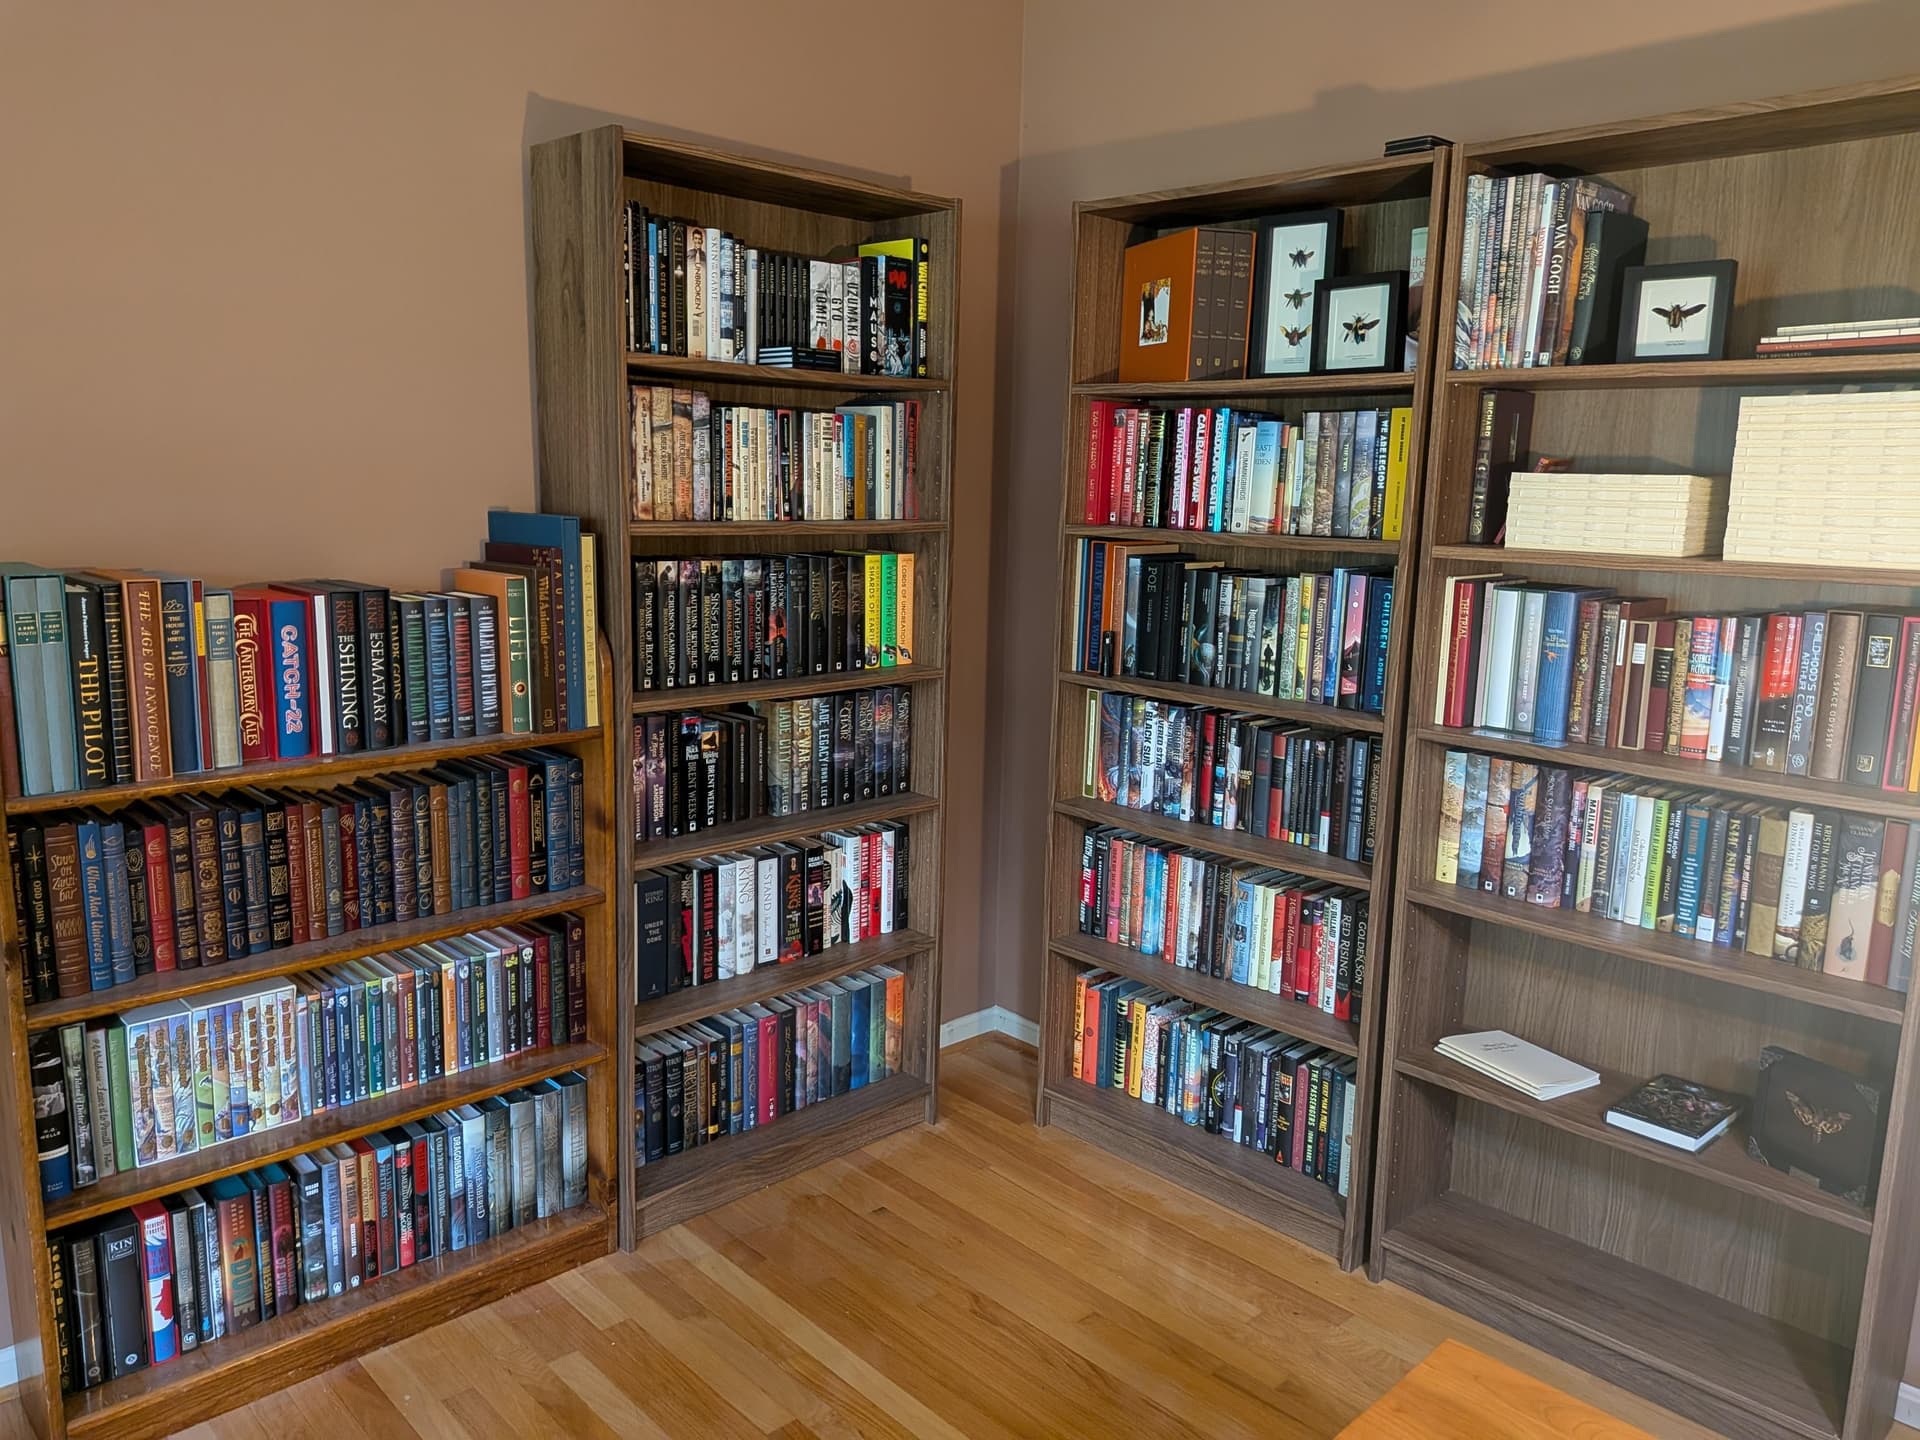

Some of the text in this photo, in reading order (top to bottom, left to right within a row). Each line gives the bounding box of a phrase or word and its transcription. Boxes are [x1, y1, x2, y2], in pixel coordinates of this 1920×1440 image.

[1547, 182, 1569, 294] Essential VAN GOGH
[661, 297, 667, 307] ON
[694, 262, 703, 310] UNBROKEN
[918, 262, 927, 322] WATCHMEN
[816, 290, 827, 327] TOMIE
[832, 298, 842, 322] GYO
[847, 282, 858, 336] UZUMAKI
[1125, 420, 1135, 455] DESTROYER
[1485, 401, 1493, 437] RICHARD
[1171, 413, 1185, 512] LEVIATHAN WAKES
[1192, 414, 1206, 503] CALIBAN'S WAR
[1208, 413, 1224, 514] ABADDON'S GATE
[1239, 450, 1248, 501] HUMMINGBIRDS
[1377, 420, 1388, 489] WE ARE LEGION
[1123, 466, 1131, 493] WORLDS
[539, 575, 549, 600] Wild
[868, 566, 876, 593] SHARDS
[900, 589, 906, 598] OF
[1147, 567, 1158, 593] POE
[335, 600, 346, 633] KING
[367, 597, 377, 629] KING
[667, 595, 675, 629] CRIMSON
[869, 597, 876, 607] OF
[1459, 599, 1470, 638] THE TRIAL
[509, 616, 523, 661] LIFE
[554, 558, 567, 724] FAUST GOETHE
[645, 592, 654, 675] PROMISE OF BLOOD
[1312, 597, 1327, 676] Ratman's Notebook
[1376, 593, 1391, 686] CHILDREN ADRIAN
[1602, 636, 1610, 653] CITY
[281, 624, 302, 734] CATCH-22
[370, 632, 387, 724] PET SEMATARY
[407, 621, 426, 719] COLLECTED FICTION
[477, 616, 497, 711] COLLECTED FICTION
[1601, 654, 1608, 664] OF
[1798, 652, 1809, 689] ARTHUR
[1804, 622, 1823, 717] CHILDHOOD'S END
[138, 591, 161, 772] THE AGE OF INNOCENCE
[338, 635, 358, 729] THE SHINING
[1598, 666, 1607, 702] DREAMING
[78, 655, 106, 780] THE PILOT
[799, 706, 810, 732] JADE
[819, 703, 830, 725] JADE
[1792, 704, 1802, 741] CLARKE
[799, 738, 811, 762] WAR
[819, 729, 830, 763] LEGACY
[1143, 711, 1153, 767] BLACK SUN
[688, 762, 697, 819] BRENT WEEKS
[707, 765, 715, 815] BRENT WEEKS
[1369, 763, 1380, 801] SCANNER
[534, 799, 542, 842] TIMESCAPE
[1367, 804, 1377, 837] DARKLY
[1586, 799, 1597, 845] MAILMAN
[1084, 836, 1093, 857] CATCH
[1598, 807, 1611, 883] THE TONTINE
[1808, 822, 1822, 890] THE FOUR WINDS
[1817, 825, 1832, 891] KRISTIN HANNAH
[738, 866, 749, 905] KING
[763, 874, 773, 911] STAND
[1082, 868, 1092, 882] KILL
[1663, 866, 1673, 901] JOHN SCALZI
[1720, 819, 1740, 930] ISAAC ASIMOV NEMESIS
[33, 881, 45, 924] ODD JOHN
[86, 865, 104, 963] What Mad Universe
[703, 874, 713, 980] STEPHEN KING 11/22/63
[1339, 914, 1352, 977] RED RISING
[1355, 921, 1367, 984] GOLDEN SON
[1311, 1069, 1320, 1083] THE
[1321, 1081, 1330, 1098] EVERY
[1308, 1084, 1318, 1126] PASSENGERS
[1320, 1099, 1329, 1111] MAN
[453, 1136, 463, 1188] DRAGONSBANE
[400, 1174, 409, 1210] MERIDIAN
[109, 1236, 133, 1251] KIN
[230, 1260, 256, 1317] DUNE
[262, 1267, 273, 1305] MESSIAH
[277, 1257, 287, 1297] OF DUNE
